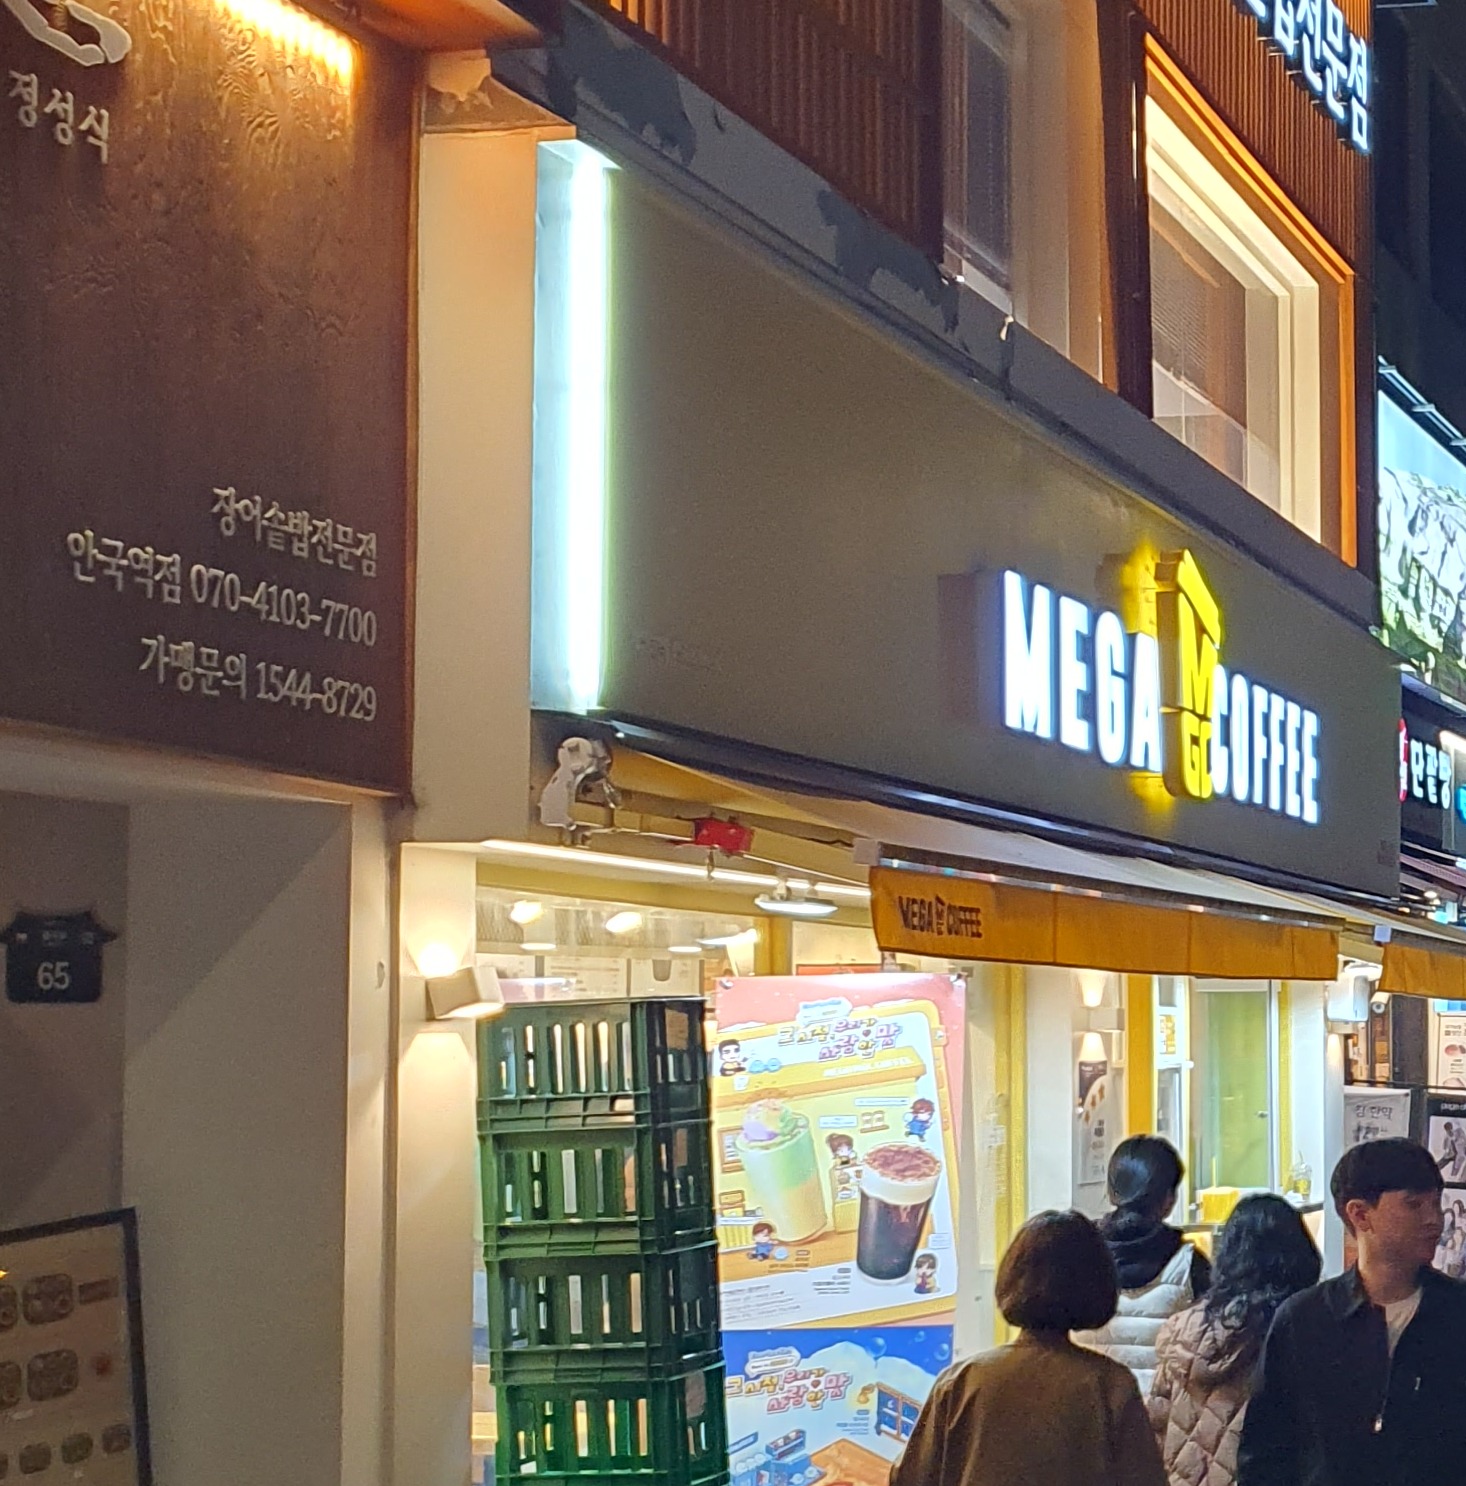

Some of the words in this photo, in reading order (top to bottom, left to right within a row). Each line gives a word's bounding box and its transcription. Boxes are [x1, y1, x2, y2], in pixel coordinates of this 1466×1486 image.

[8, 70, 109, 164] 정성식
[210, 486, 377, 577] 장어솥밥전문점
[66, 529, 181, 604] 안국역점
[190, 563, 377, 647] 070-4103-7700
[139, 634, 247, 699] 가맹문의
[255, 661, 377, 721] 1544-8729
[1003, 569, 1162, 772] MEGA
[1211, 664, 1318, 824] COFFEE
[37, 961, 70, 990] 65
